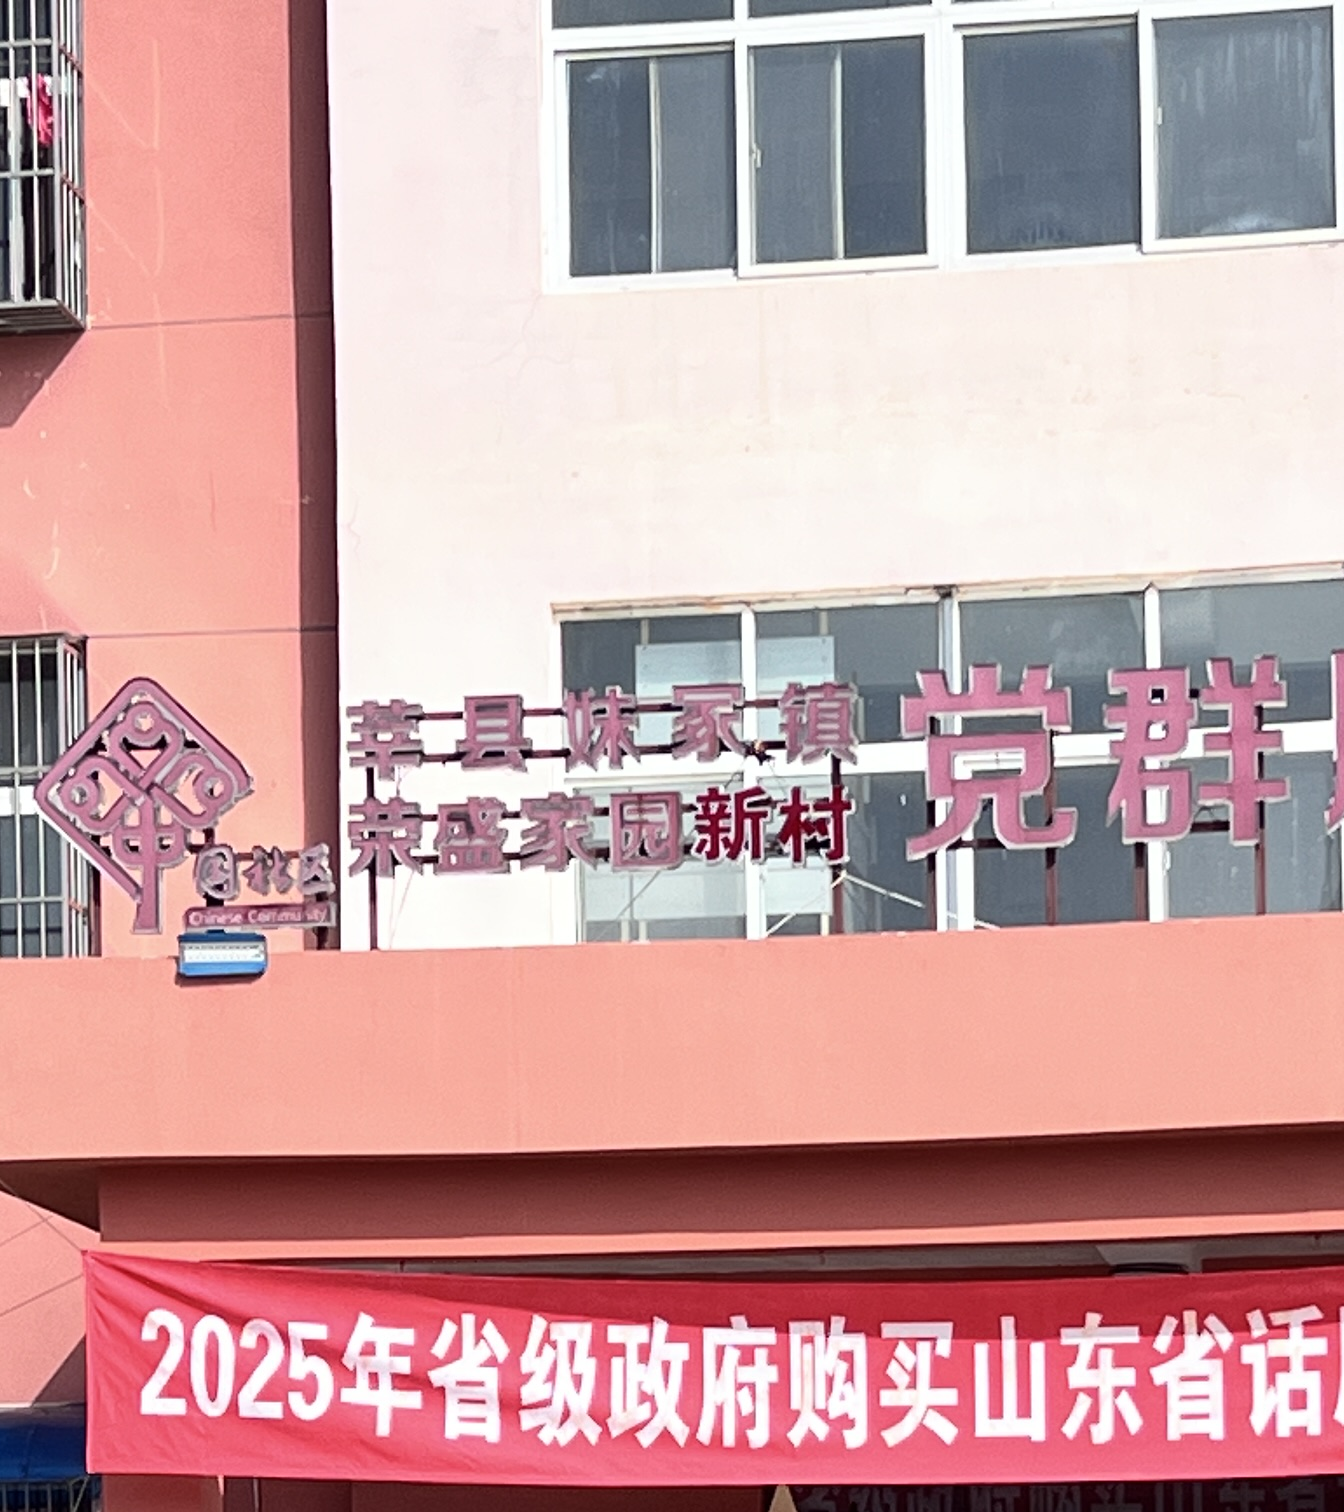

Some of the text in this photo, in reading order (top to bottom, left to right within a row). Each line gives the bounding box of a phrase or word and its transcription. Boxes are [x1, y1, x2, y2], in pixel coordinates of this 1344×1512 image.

[346, 682, 859, 780] 莘县妹冢镇
[348, 785, 853, 878] 荣盛家园新村
[188, 910, 243, 926] Chinese
